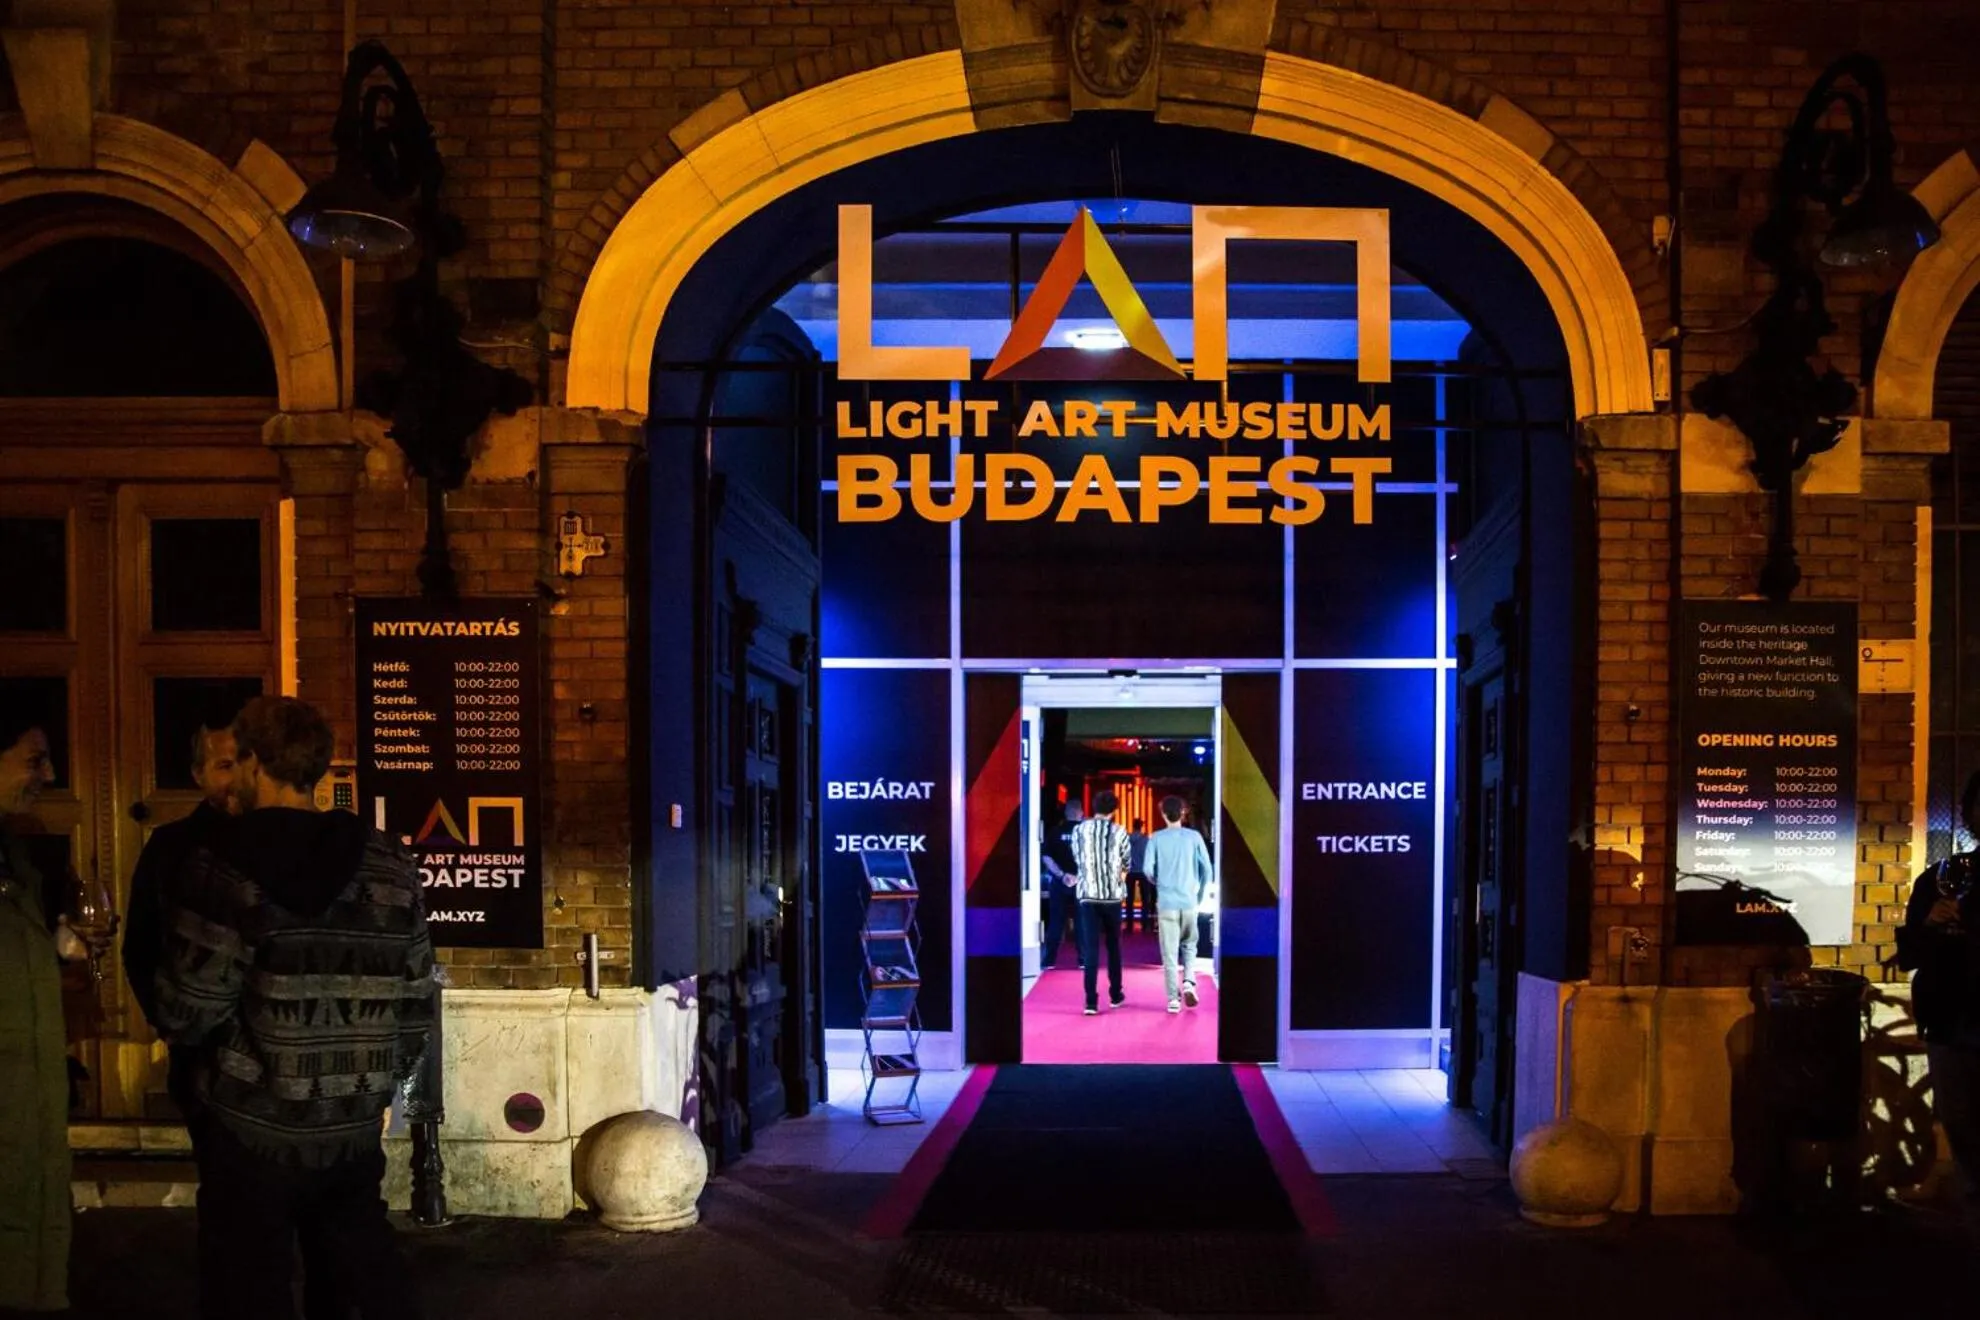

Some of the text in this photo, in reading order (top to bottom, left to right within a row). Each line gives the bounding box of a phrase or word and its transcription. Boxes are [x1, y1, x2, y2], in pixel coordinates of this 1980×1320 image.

[836, 400, 1392, 441] LIGHT ART MUSEUM
[836, 453, 1393, 526] BUDAPEST
[372, 618, 521, 637] NYITVATARTÁS
[1698, 622, 1836, 634] Our museum is located
[1699, 638, 1809, 652] inside the heritage
[1699, 654, 1764, 665] Downtown
[1766, 655, 1807, 666] Market
[453, 661, 521, 673] 10:00-22:00
[372, 677, 521, 689] Kedd: 10:00-22:00
[1697, 671, 1736, 684] giving
[1747, 673, 1773, 682] new
[1775, 670, 1825, 682] function
[1826, 671, 1840, 683] to
[373, 694, 521, 705] Szerda: 10:00-22:00
[1697, 686, 1817, 700] the historic building.
[454, 710, 521, 722] 10:00-22:00
[373, 726, 521, 738] Péntek: 10:00-22:00
[1697, 733, 1838, 747] OPENING HOURS
[373, 743, 521, 754] Szombat: 10:00-22:00
[374, 759, 522, 772] Vasárnap: 10:00-22:00
[1696, 766, 1838, 778] Monday: 10:00-22:00
[827, 777, 936, 800] BEJÁRAT
[1302, 781, 1427, 800] ENTRANCE
[1696, 782, 1838, 794] Tuesday: 10:00-22:00
[1696, 798, 1837, 810] Wednesday: 10:00-22:00
[1695, 814, 1837, 827] Thursday: 10:00-22:00
[1695, 830, 1837, 842] Friday: 10:00-22:00
[834, 835, 927, 852] JEGYEK
[1316, 835, 1411, 853] TICKETS
[424, 853, 455, 866] ART
[459, 853, 525, 866] MUSEUM
[418, 868, 525, 888] DAPEST
